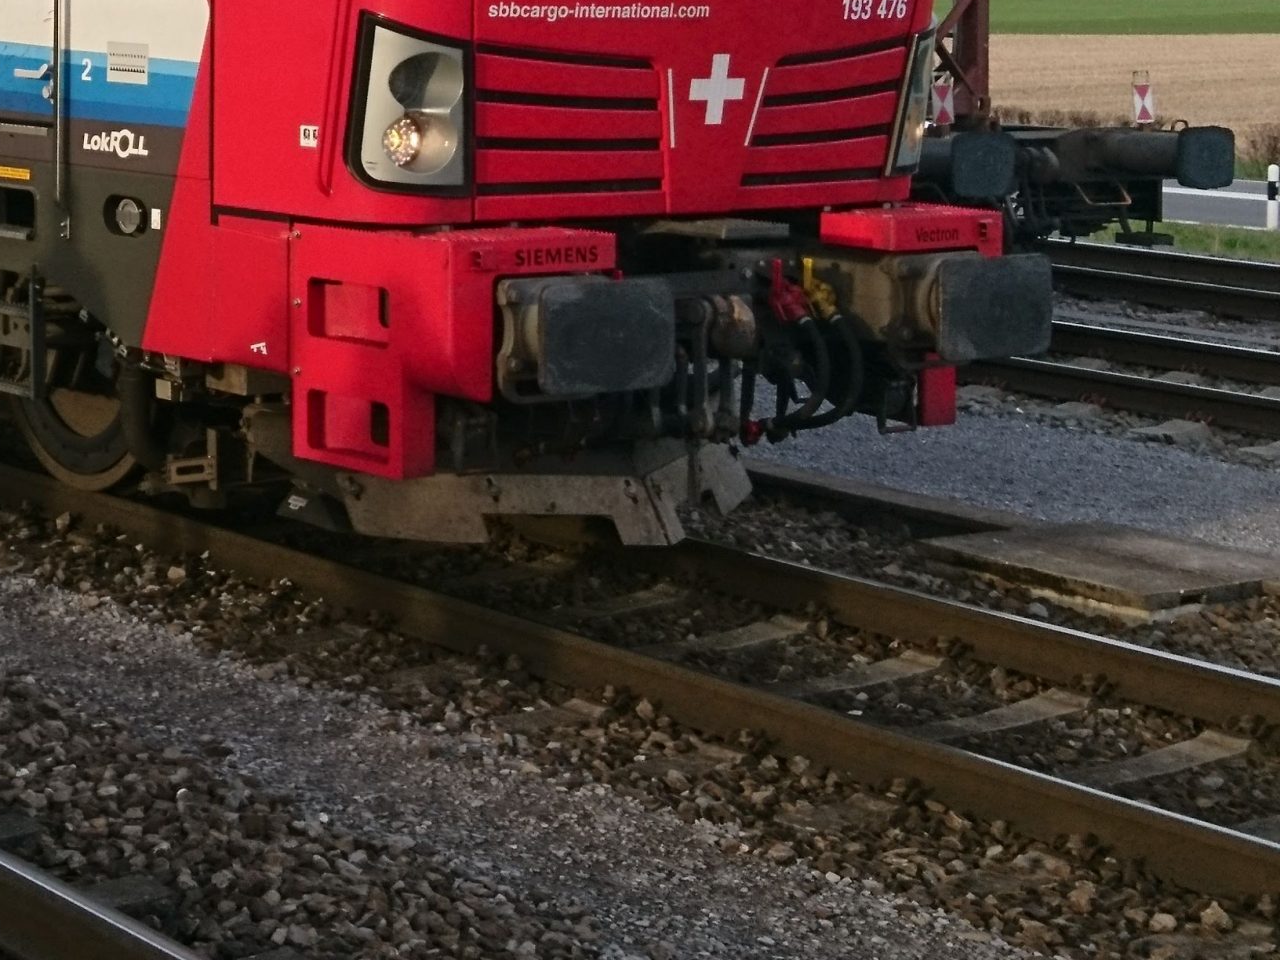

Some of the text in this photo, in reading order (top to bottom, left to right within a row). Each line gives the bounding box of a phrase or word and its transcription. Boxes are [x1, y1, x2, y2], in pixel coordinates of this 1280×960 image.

[488, 1, 710, 22] sbbcargo-international.com
[81, 58, 92, 81] 2
[915, 227, 959, 242] Vectron
[515, 246, 598, 266] SIEMENS
